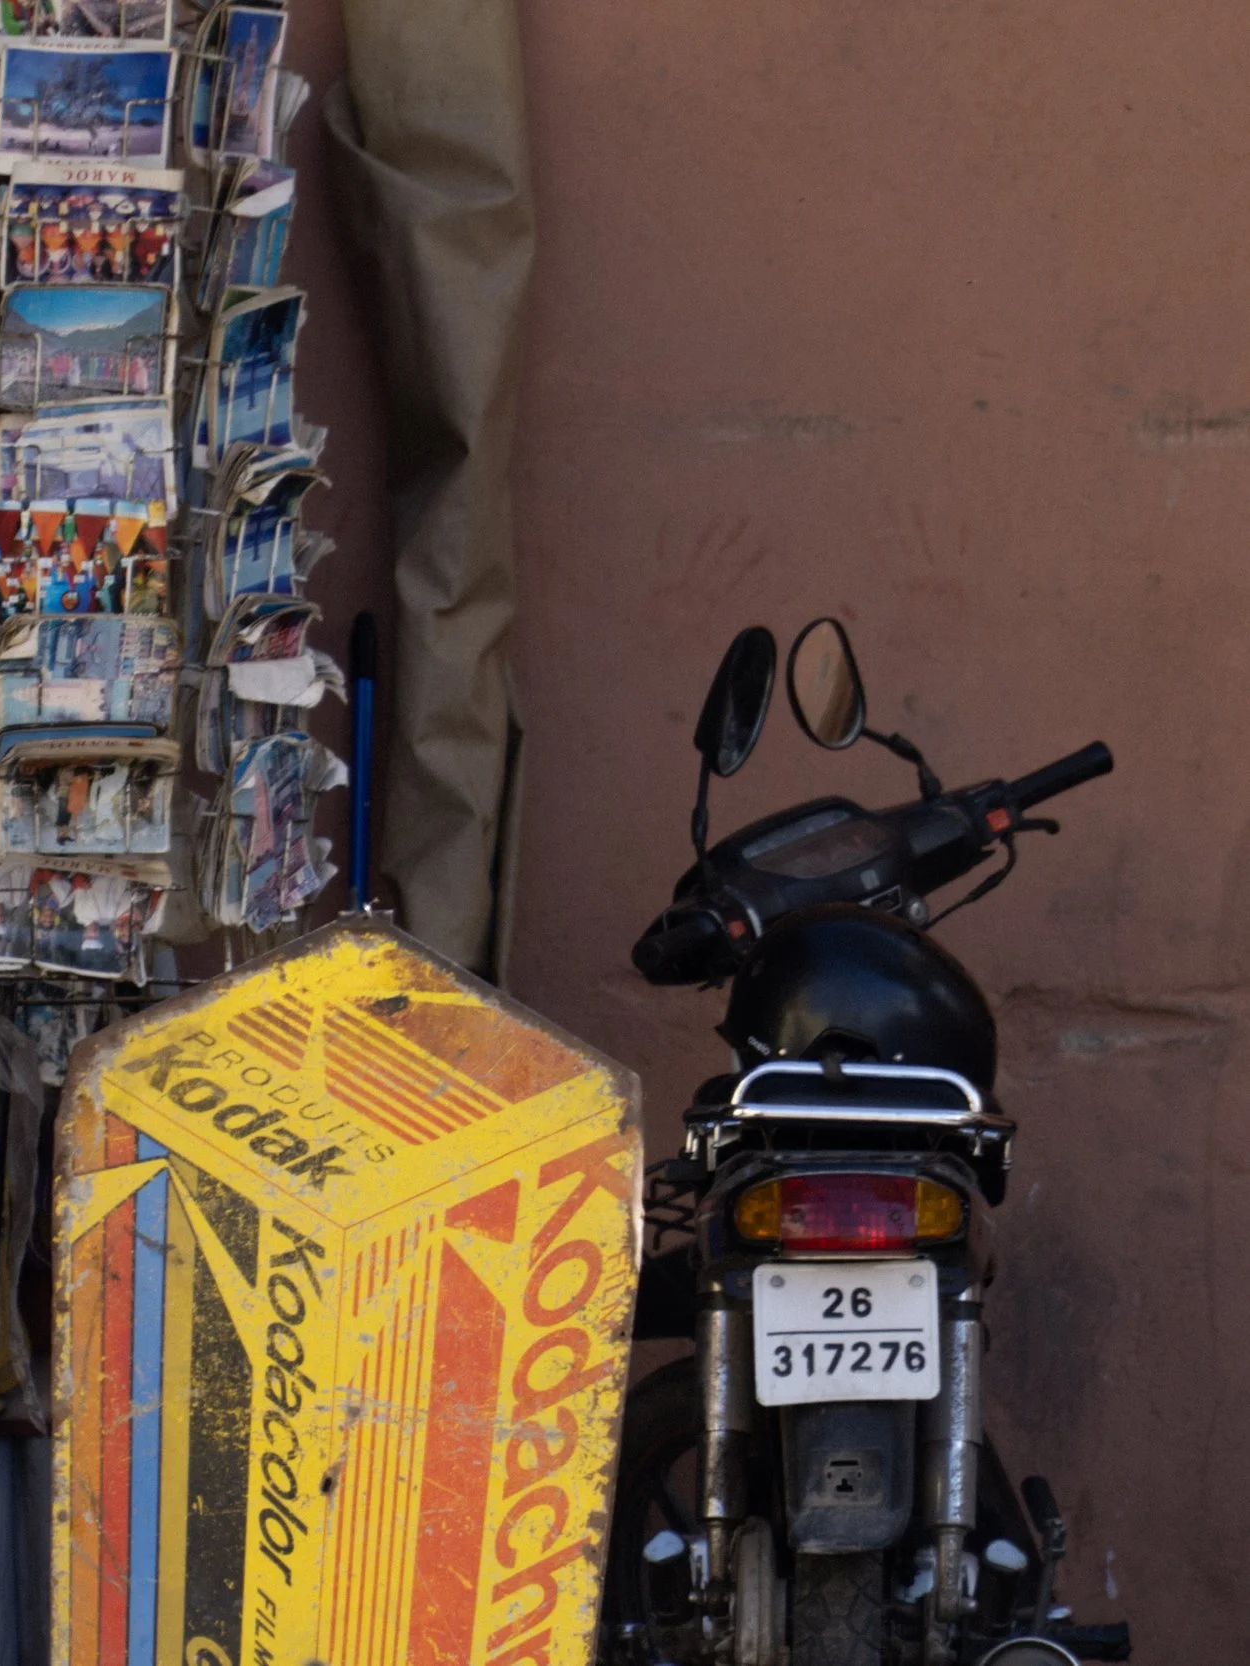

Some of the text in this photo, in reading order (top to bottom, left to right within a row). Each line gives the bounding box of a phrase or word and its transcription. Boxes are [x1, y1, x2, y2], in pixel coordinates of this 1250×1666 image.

[66, 168, 135, 184] MAROC
[123, 1045, 355, 1193] Kodak
[184, 1031, 396, 1164] PRODUITS
[822, 1287, 872, 1318] 26
[772, 1340, 926, 1377] 317276
[253, 1217, 326, 1666] Kodacolor FILM
